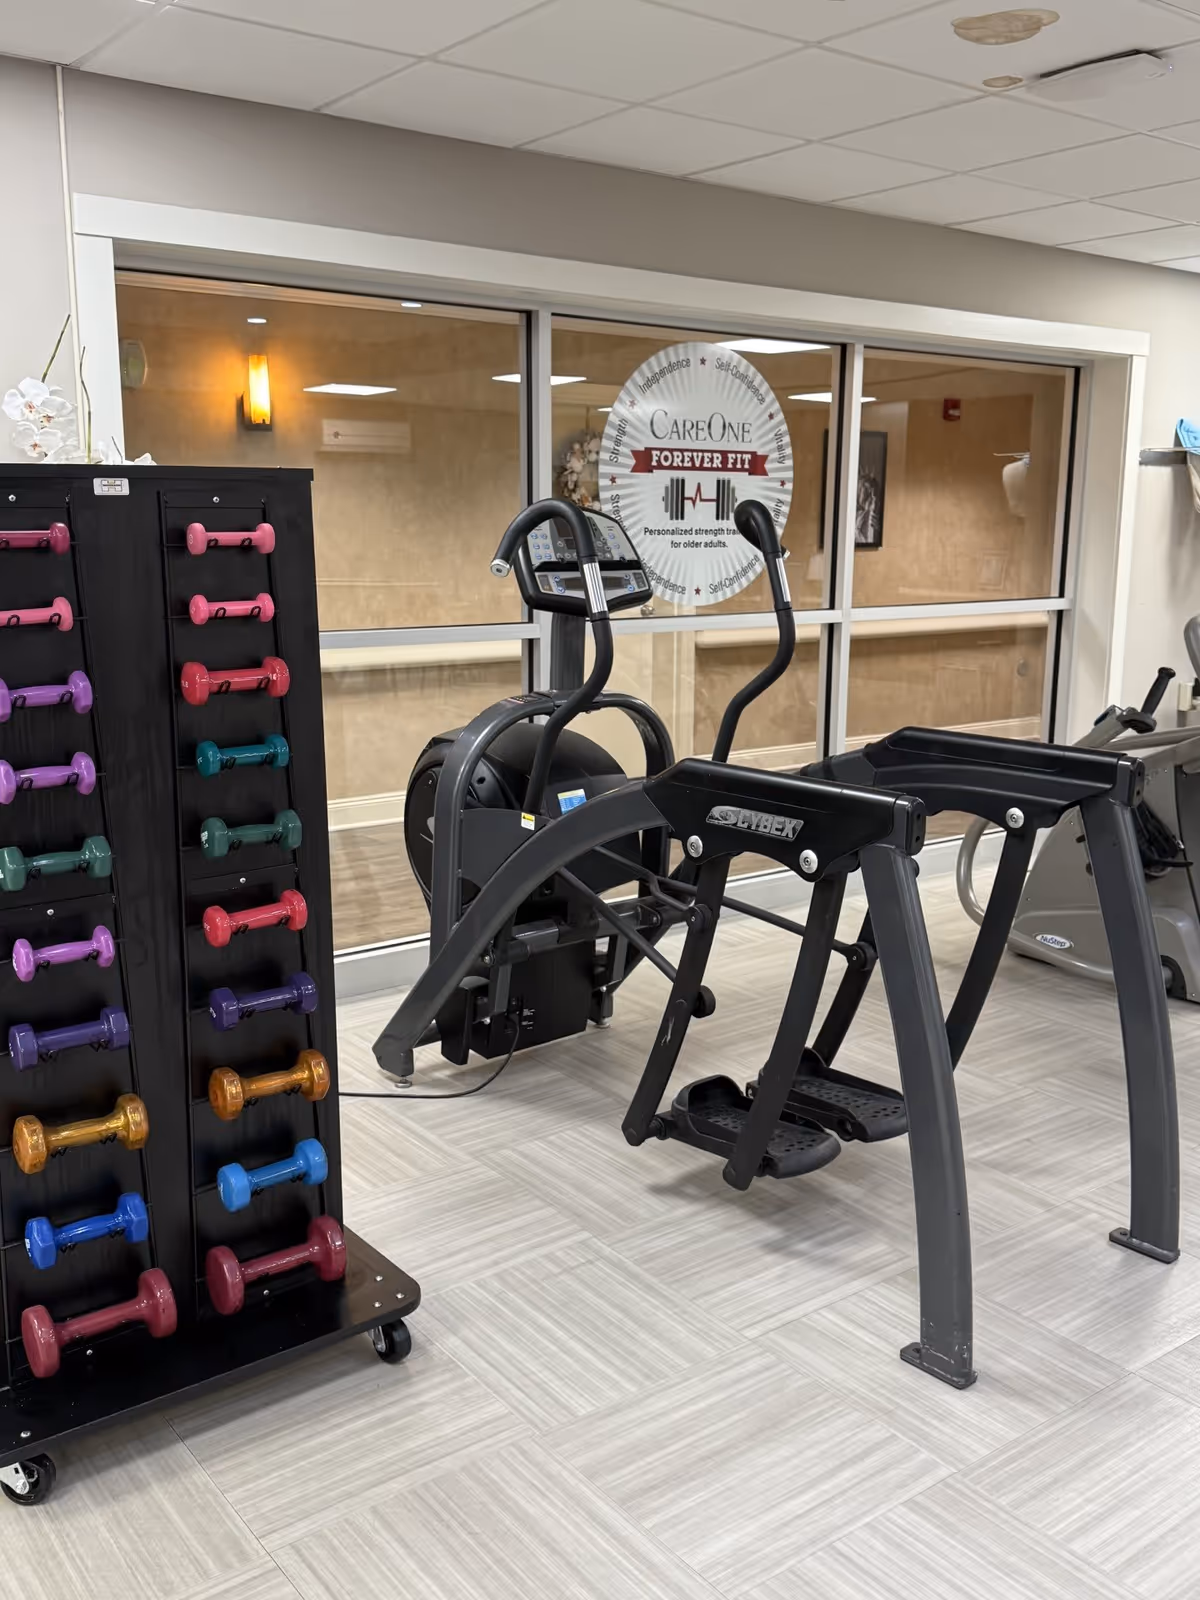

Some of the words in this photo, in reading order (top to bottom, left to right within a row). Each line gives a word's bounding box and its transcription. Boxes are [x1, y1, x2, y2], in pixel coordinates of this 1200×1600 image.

[639, 357, 691, 394] Independence
[714, 357, 766, 405] Self-Confidence
[608, 417, 629, 464] Strength
[773, 428, 786, 465] Vitality
[651, 450, 722, 468] FOREVER
[726, 453, 752, 469] FIT
[643, 526, 693, 537] Personalized
[694, 527, 725, 538] strength
[670, 540, 682, 549] for
[682, 540, 703, 549] older
[703, 540, 729, 549] adults.
[708, 553, 761, 595] Self-Confidence
[1040, 935, 1067, 947] NuStep
